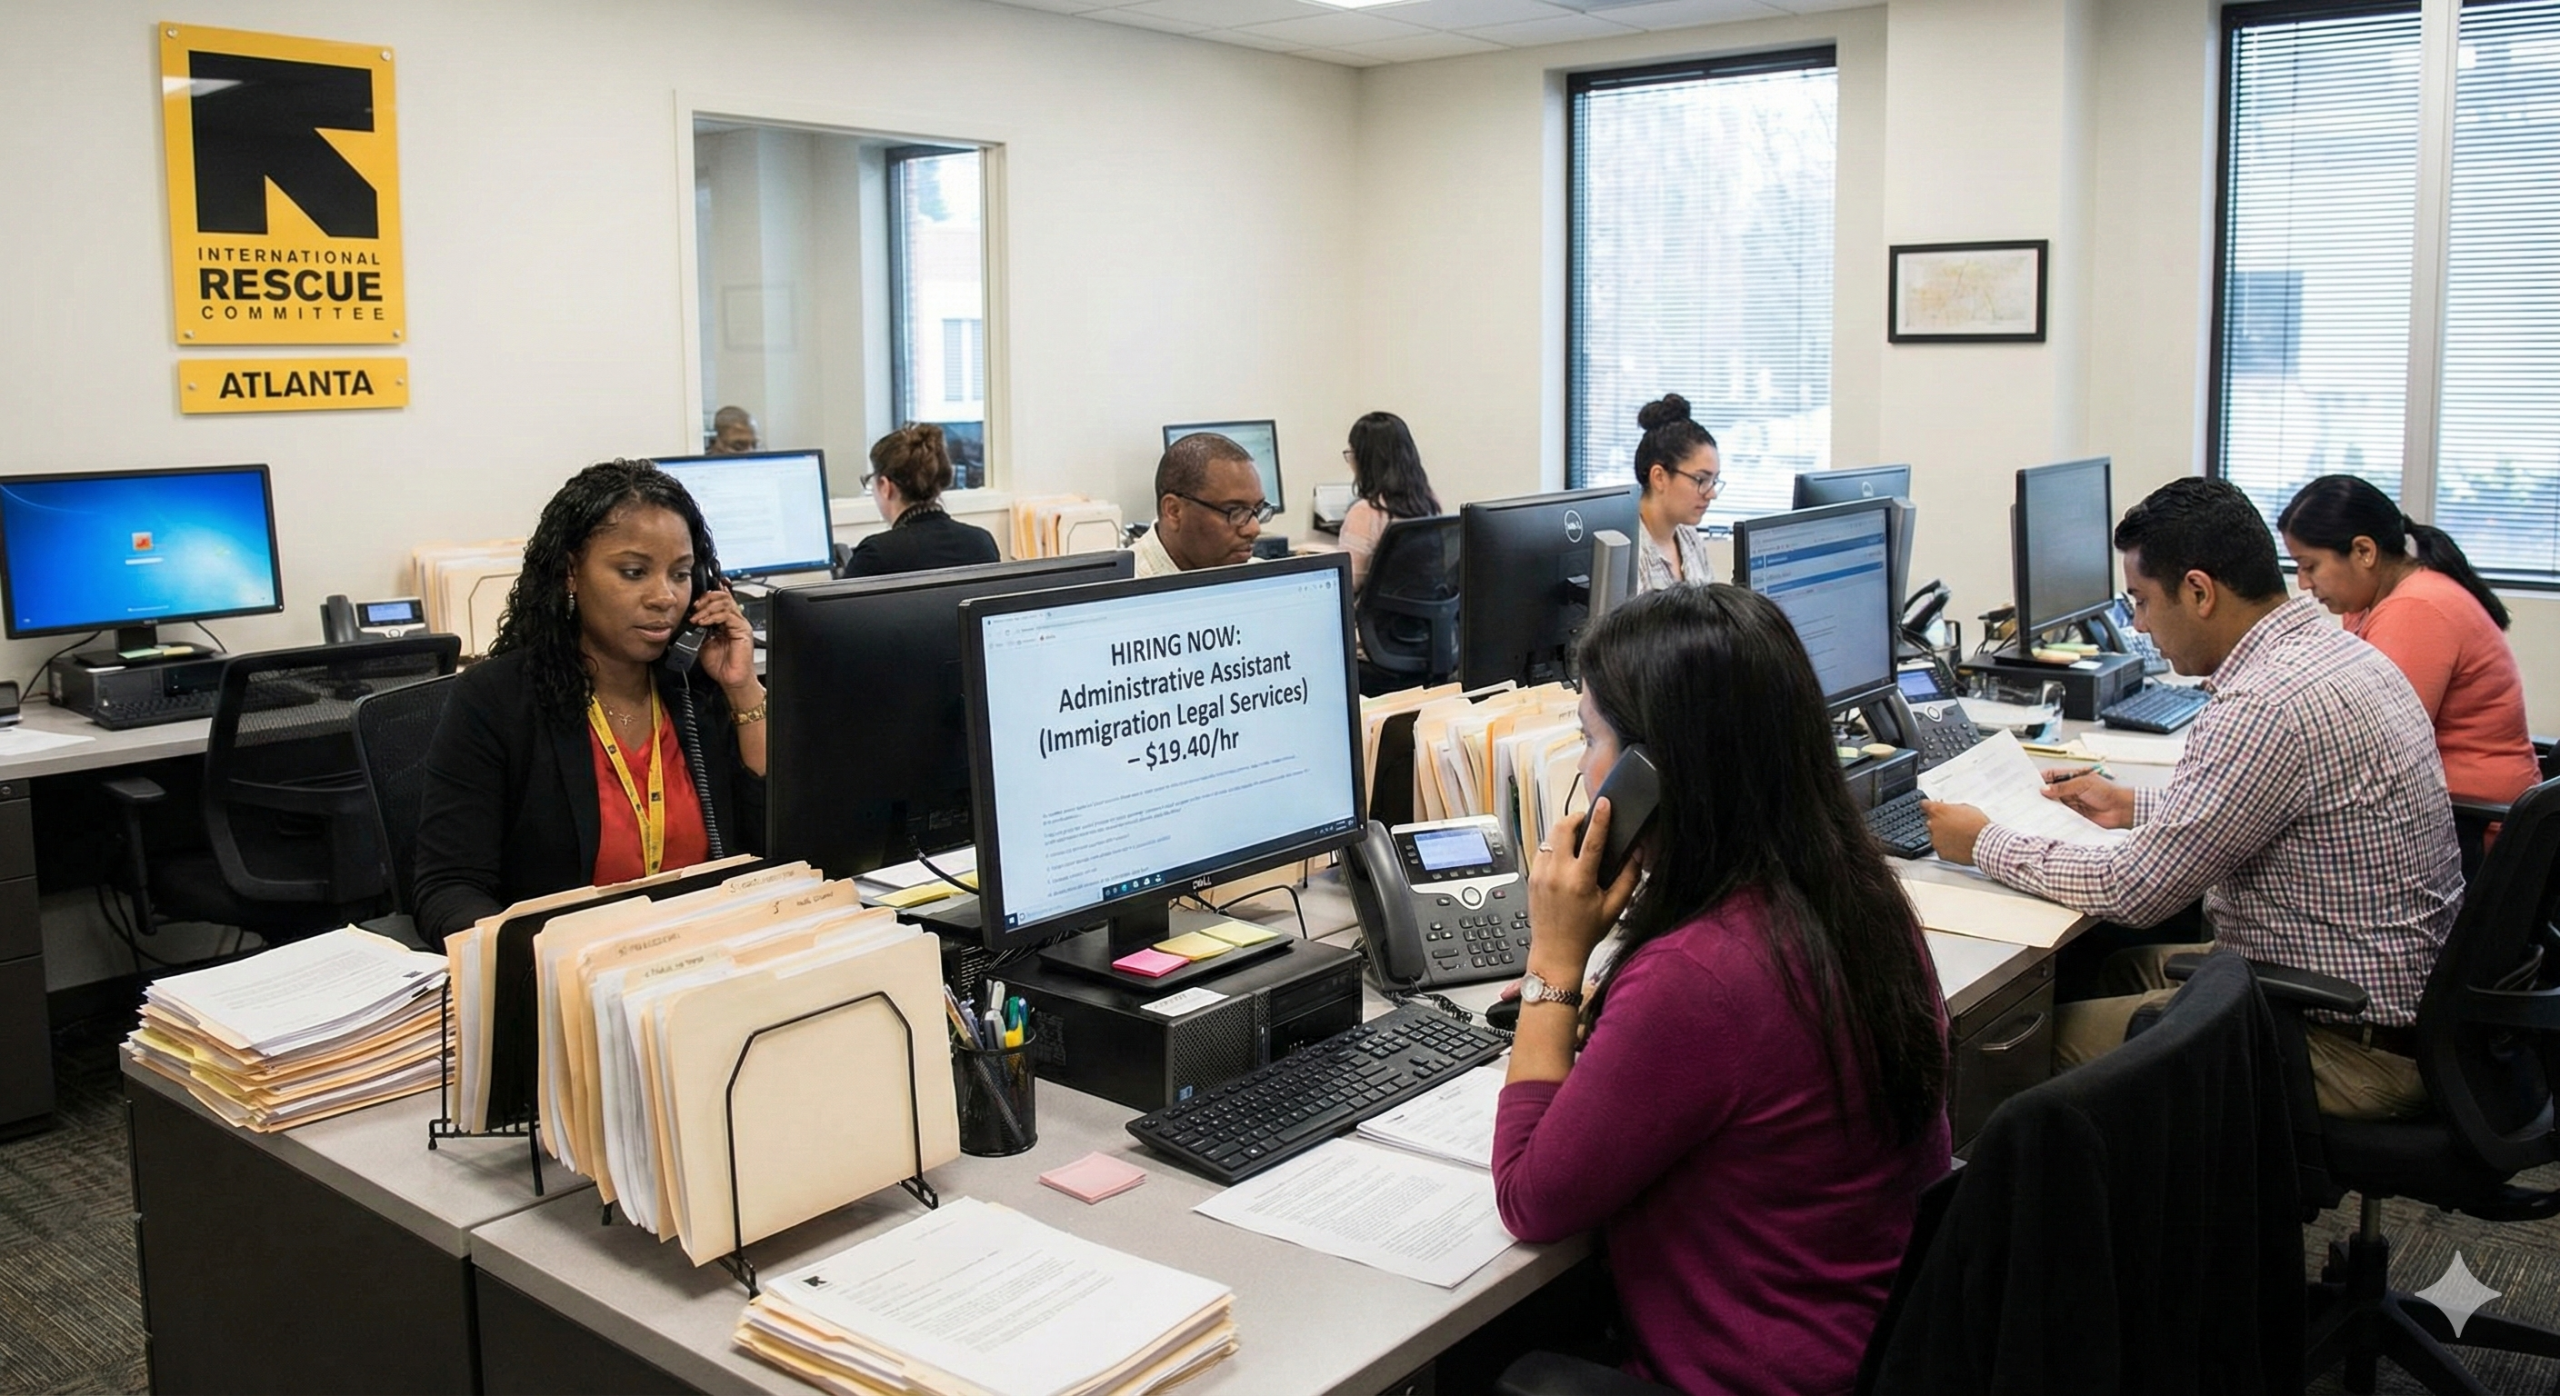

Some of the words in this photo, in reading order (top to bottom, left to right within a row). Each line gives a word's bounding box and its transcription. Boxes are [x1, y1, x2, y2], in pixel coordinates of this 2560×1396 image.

[198, 247, 380, 265] INTERNATIONAL
[199, 268, 383, 302] RESCUE
[201, 306, 384, 320] COMMITTEE
[219, 370, 374, 399] ATLANTA
[1111, 634, 1181, 666] HIRING
[1187, 625, 1241, 654] NOW:
[1059, 667, 1205, 713] Administrative
[1210, 651, 1291, 684] Assistant
[1039, 710, 1171, 759] (Immigration
[1177, 694, 1225, 726] Legal
[1230, 677, 1308, 714] Services)
[1146, 728, 1239, 771] $19.40/hr
